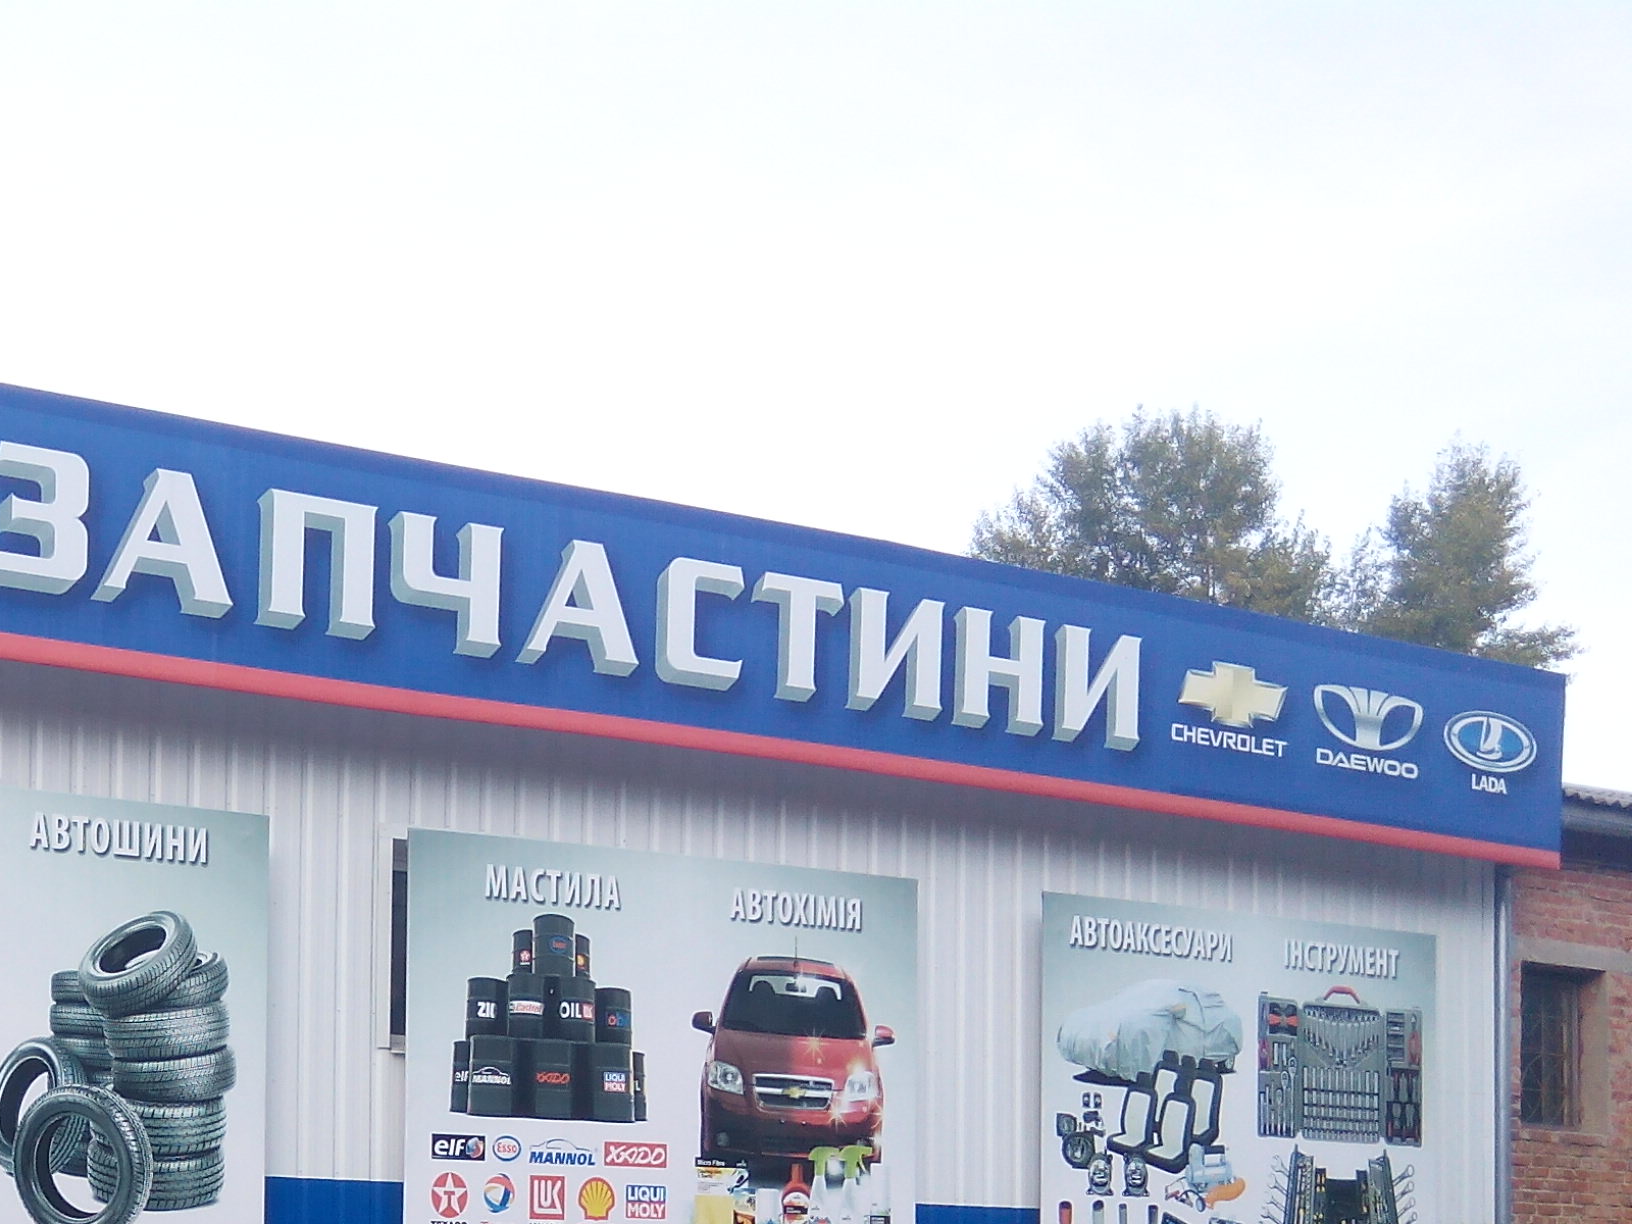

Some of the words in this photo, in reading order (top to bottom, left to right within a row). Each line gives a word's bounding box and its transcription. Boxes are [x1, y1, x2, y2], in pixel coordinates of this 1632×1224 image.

[1171, 723, 1288, 758] CHEVROLET
[1316, 748, 1418, 779] DAEWOO
[1471, 773, 1507, 794] LADA
[30, 811, 208, 865] АВТОШИНИ
[485, 863, 621, 910] МАСТИЛА
[730, 887, 862, 931] АВТОХІМІЯ
[1069, 915, 1232, 963] АВТОАКСЕСУАРИ
[1284, 938, 1399, 978] ІНСТРУМЕНТ
[434, 1137, 466, 1155] elf
[529, 1151, 595, 1166] MANNOL
[627, 1186, 665, 1201] LIQUI
[627, 1203, 665, 1218] MOLY
